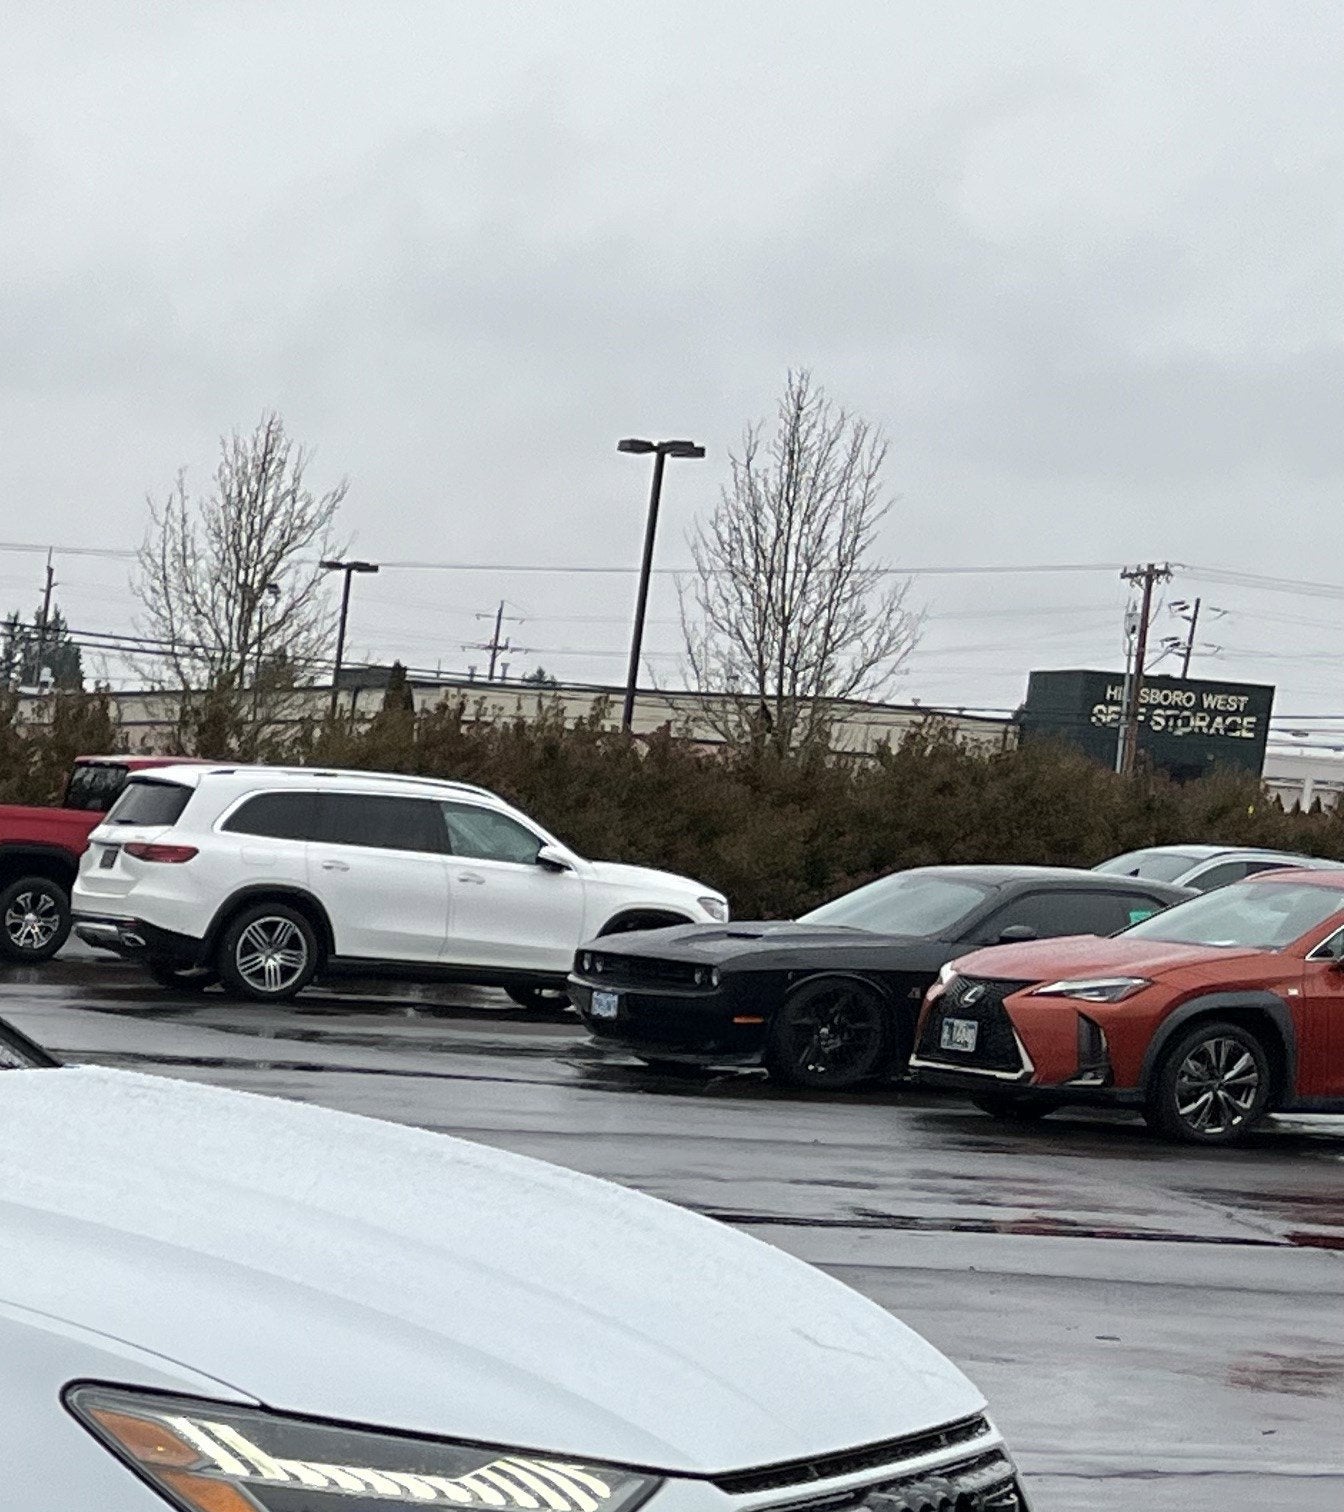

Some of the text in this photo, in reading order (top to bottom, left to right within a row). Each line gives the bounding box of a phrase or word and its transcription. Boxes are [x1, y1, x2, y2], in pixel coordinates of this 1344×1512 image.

[1105, 685, 1249, 712] HISBORO WEST
[1090, 704, 1258, 739] SEF STORAGE
